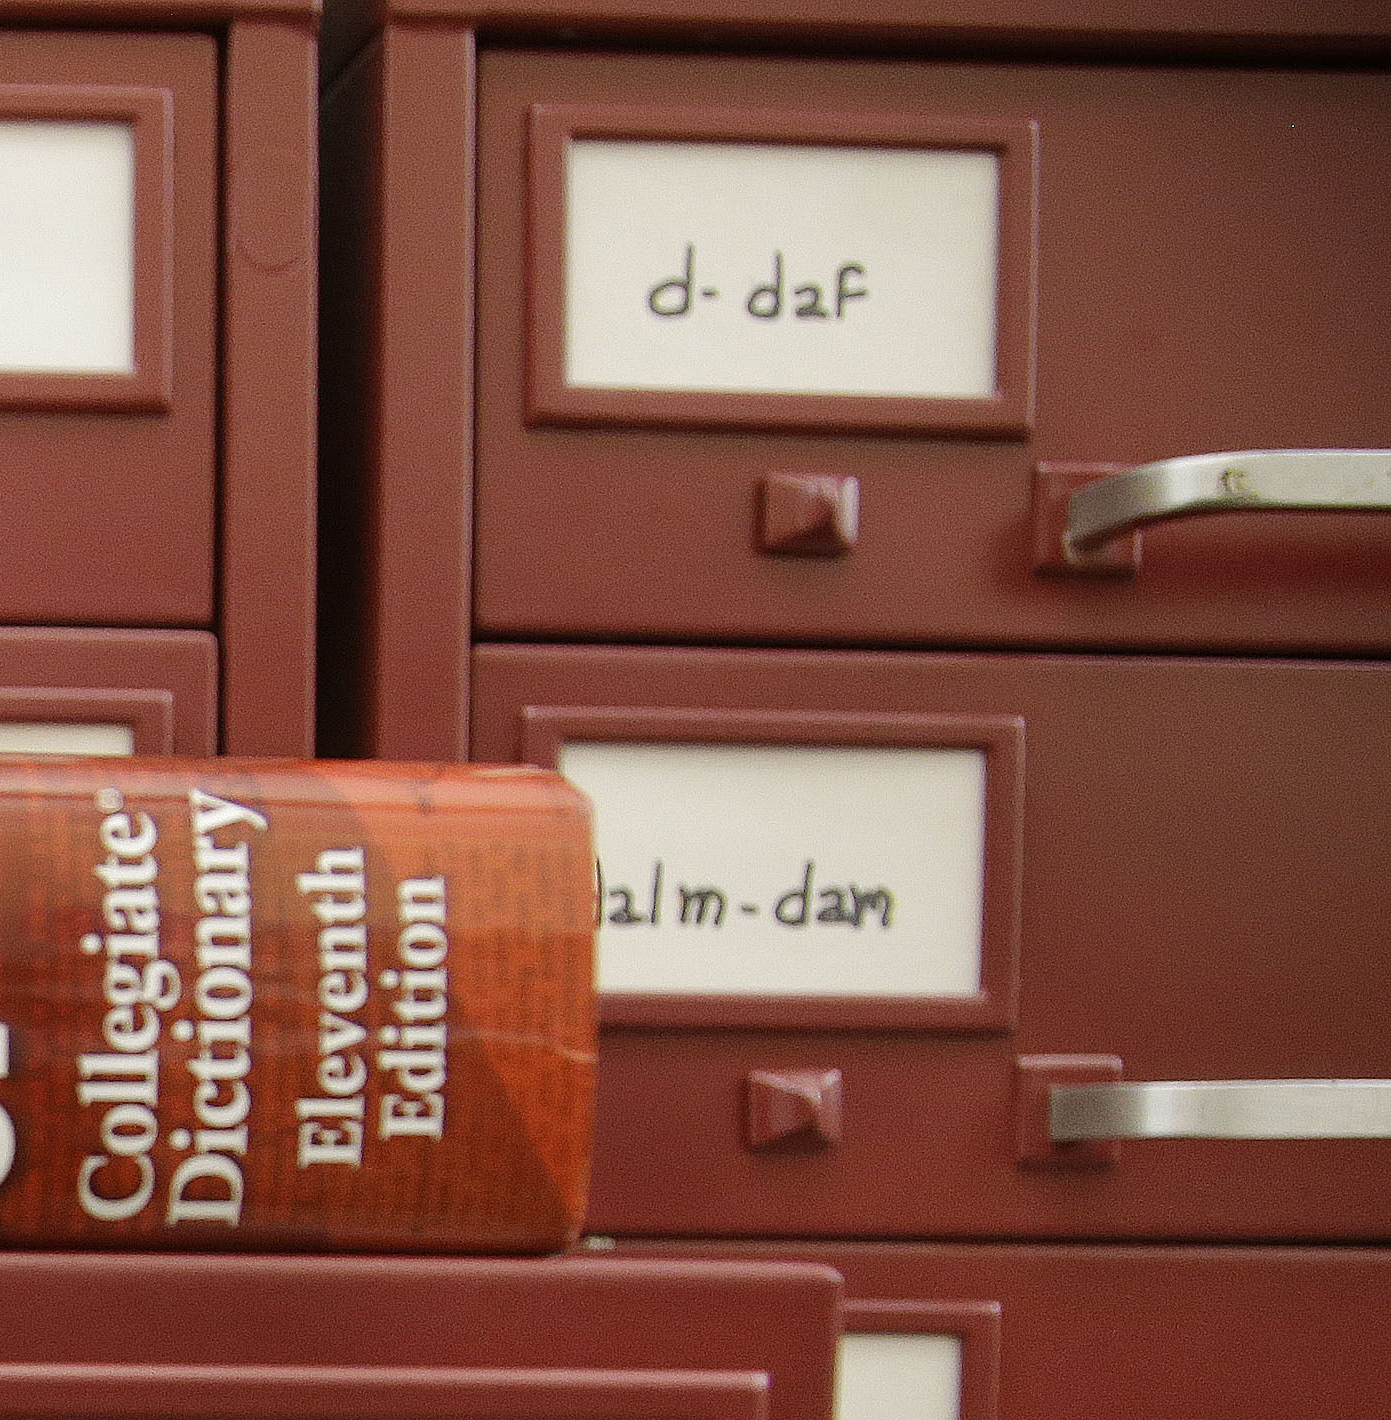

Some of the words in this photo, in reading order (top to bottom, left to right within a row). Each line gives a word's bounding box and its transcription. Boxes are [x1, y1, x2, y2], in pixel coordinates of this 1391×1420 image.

[165, 787, 269, 1229] Dictionary
[295, 845, 370, 1170] Eleventh
[377, 876, 449, 1142] Edition
